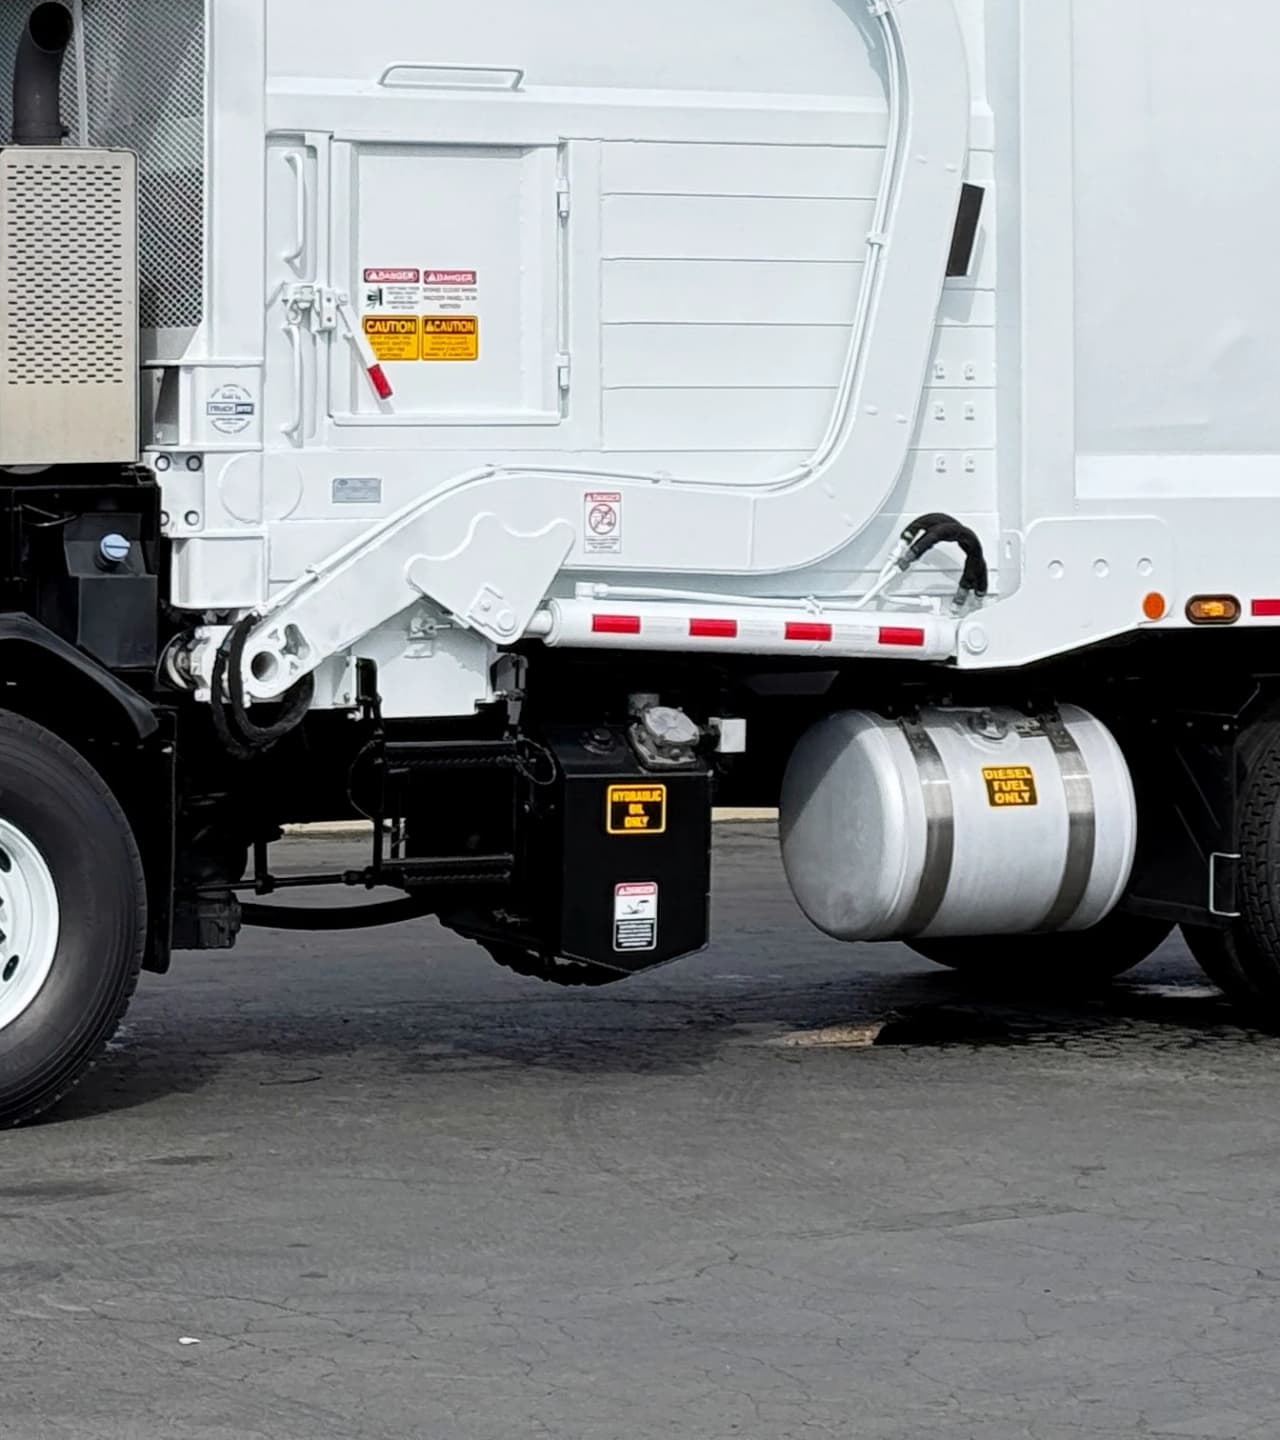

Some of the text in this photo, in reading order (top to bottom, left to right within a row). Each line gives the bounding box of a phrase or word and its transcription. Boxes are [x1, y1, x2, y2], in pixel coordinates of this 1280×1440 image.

[437, 273, 474, 282] DANGER
[366, 320, 415, 333] CAUTION
[434, 321, 474, 333] CAUTION
[983, 769, 1032, 780] DIESEL
[992, 780, 1030, 791] FUEL
[612, 790, 662, 802] HYDRAULIC
[994, 792, 1030, 804] ONLY
